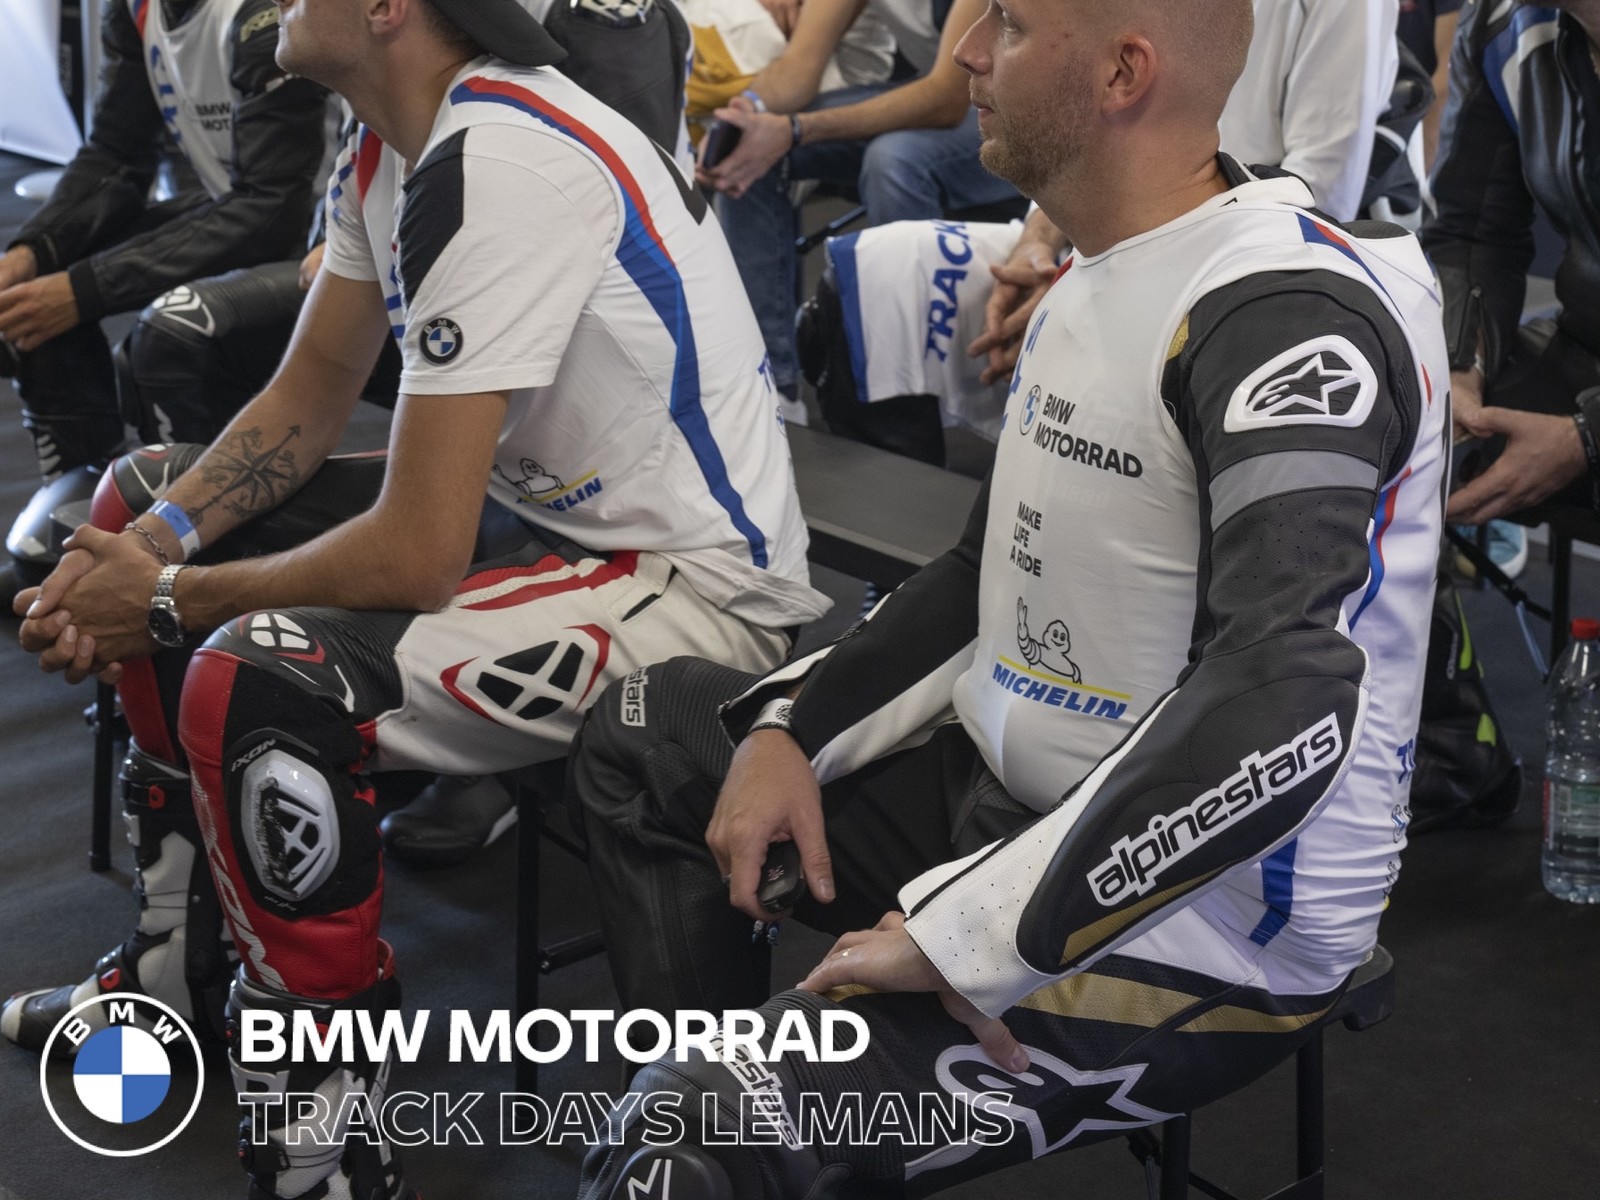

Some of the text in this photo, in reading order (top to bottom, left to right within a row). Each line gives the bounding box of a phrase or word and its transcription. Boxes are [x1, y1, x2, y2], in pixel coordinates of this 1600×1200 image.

[925, 220, 973, 363] TRACK
[1042, 393, 1076, 426] BMW
[1033, 421, 1143, 479] MOTORRAD
[1013, 525, 1030, 549] LIFE
[1017, 501, 1042, 531] MAKE
[1010, 545, 1042, 578] A RIDE
[992, 662, 1127, 720] MICHELIN
[1094, 723, 1337, 901] alpinestars
